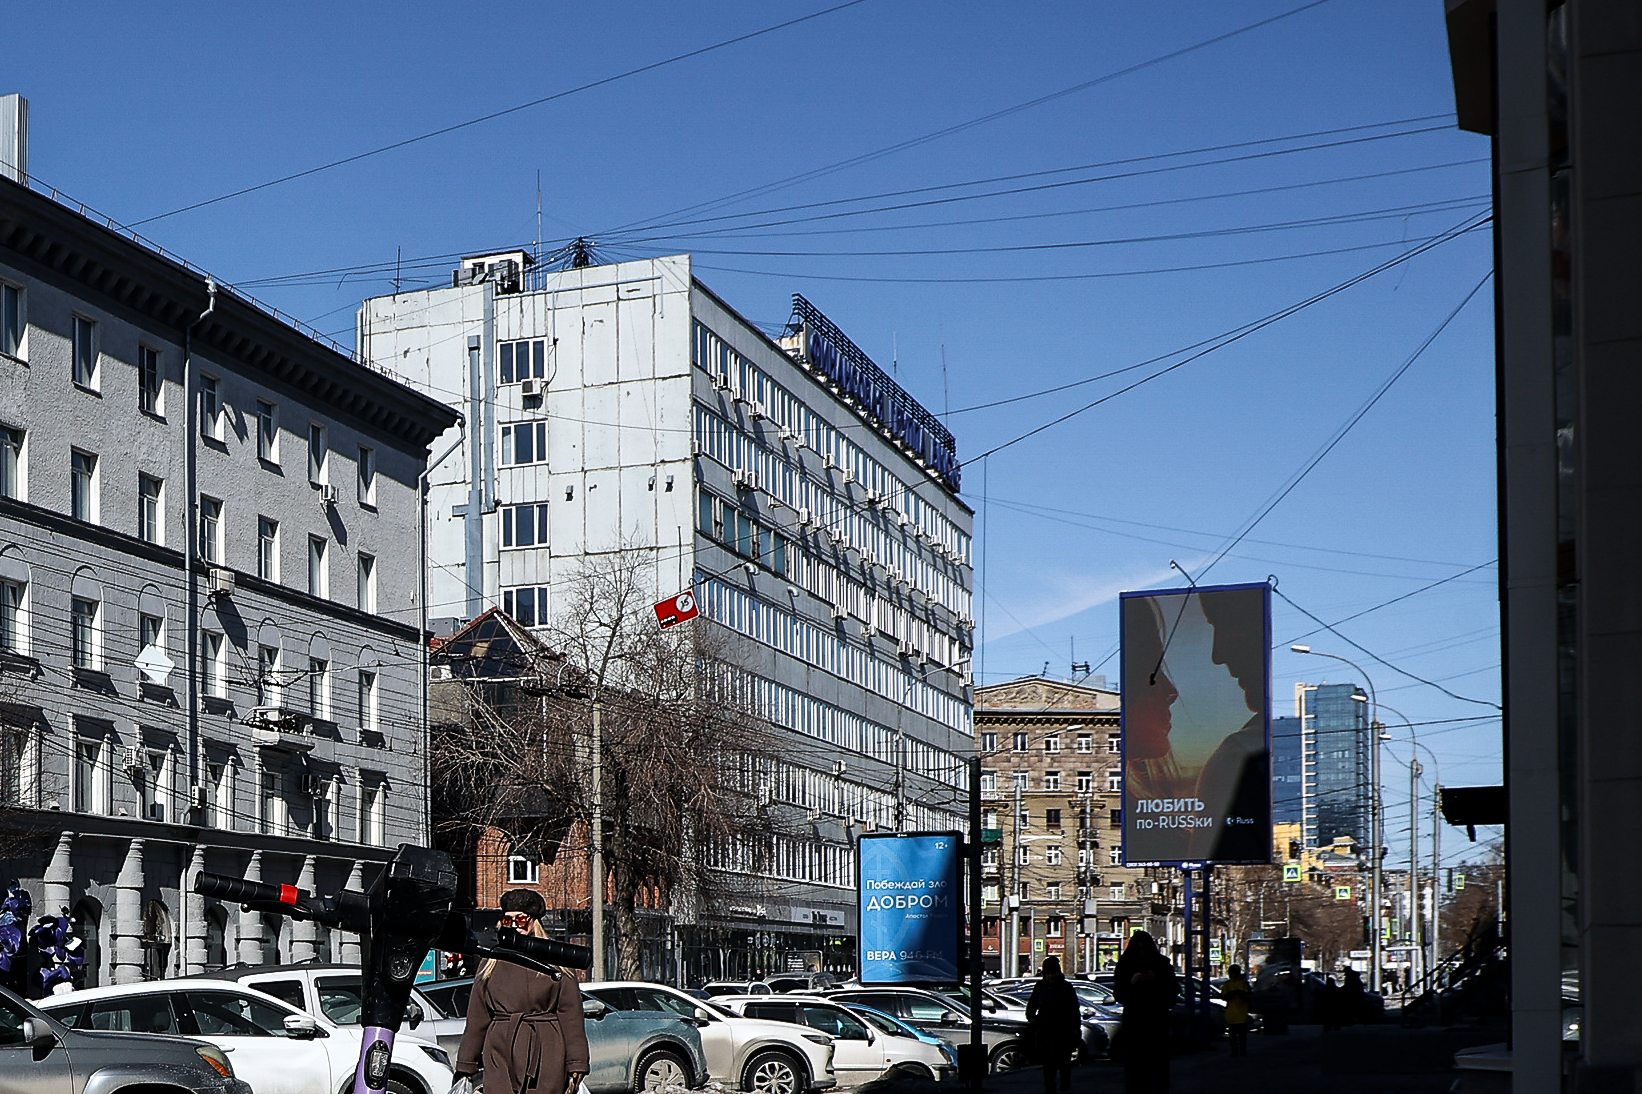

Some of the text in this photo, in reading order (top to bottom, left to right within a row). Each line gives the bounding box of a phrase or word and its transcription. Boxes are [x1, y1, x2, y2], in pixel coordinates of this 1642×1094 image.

[1135, 798, 1205, 813] ЛЮБИТЬ
[1136, 815, 1213, 829] по-RUSSки
[1236, 816, 1255, 825] Russ
[935, 842, 948, 850] 12+
[866, 879, 947, 890] Побеждай зло
[866, 895, 948, 912] ДОБРОМ
[866, 950, 897, 961] ВЕРА
